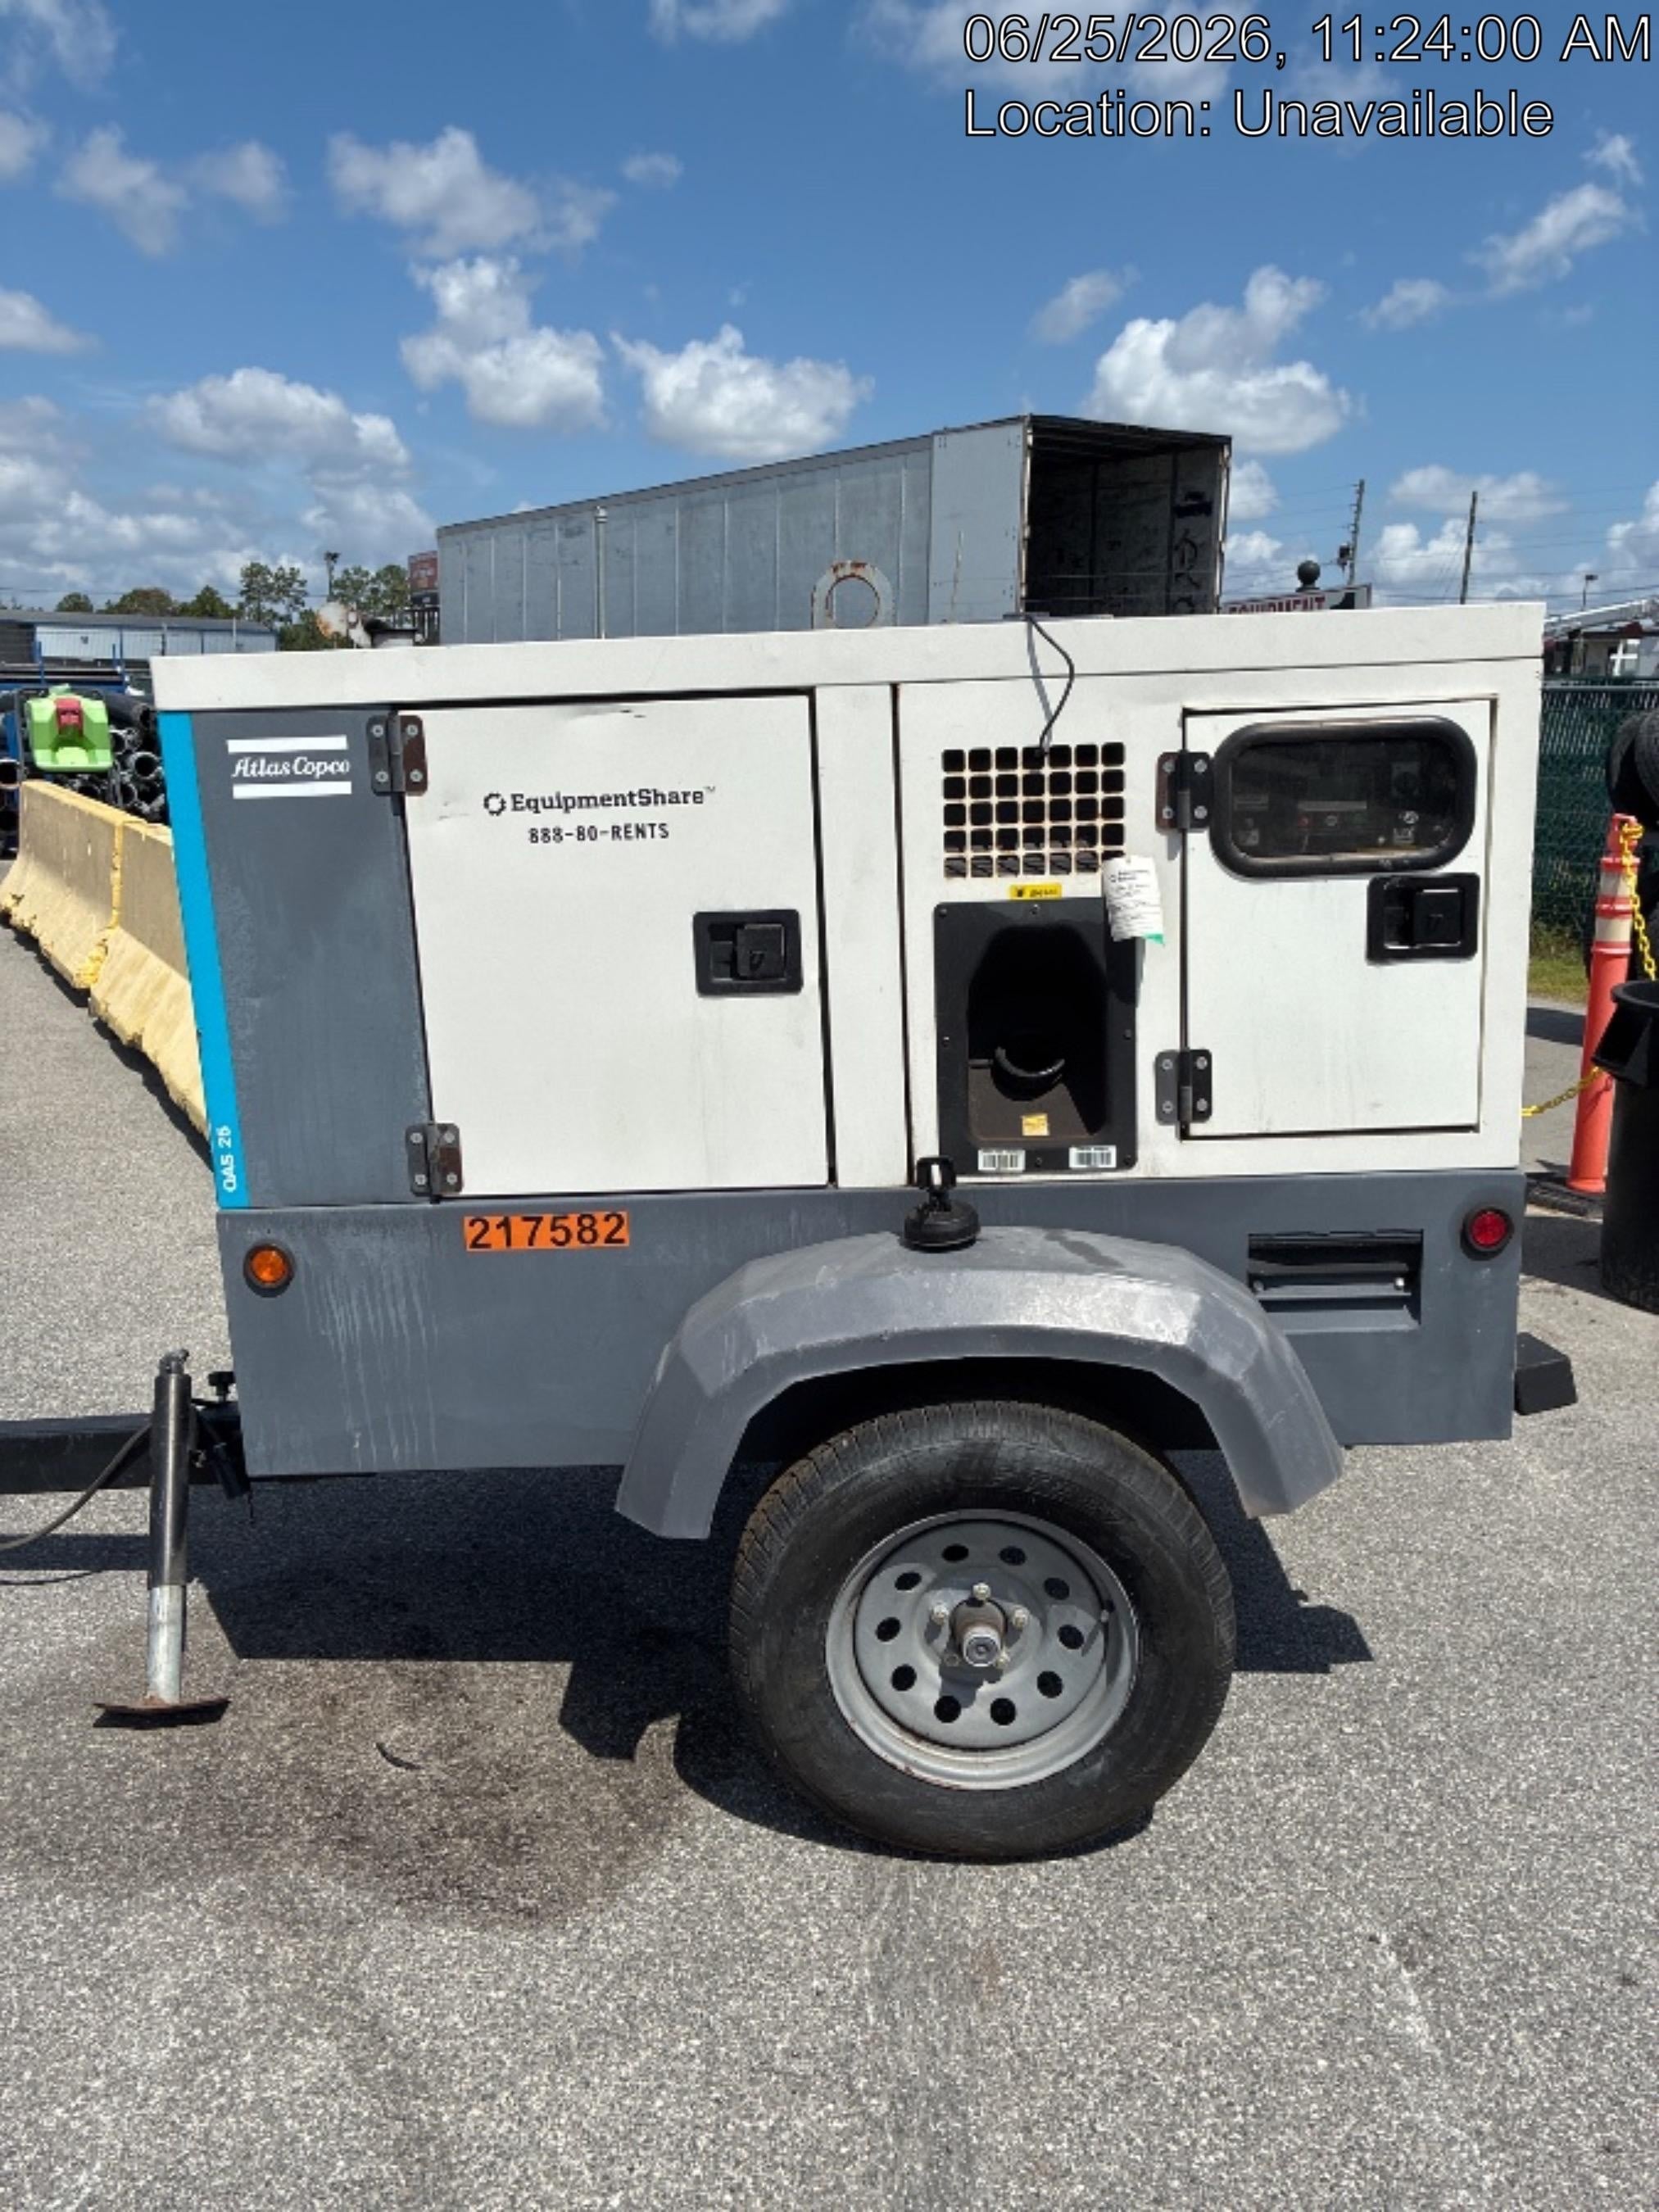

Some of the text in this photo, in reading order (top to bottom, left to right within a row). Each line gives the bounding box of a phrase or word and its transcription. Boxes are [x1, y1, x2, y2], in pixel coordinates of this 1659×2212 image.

[231, 756, 351, 780] Atlas Copco
[510, 787, 704, 814] EquipmentShare
[528, 823, 669, 845] 888-80-RENTS
[468, 1213, 626, 1249] 217582
